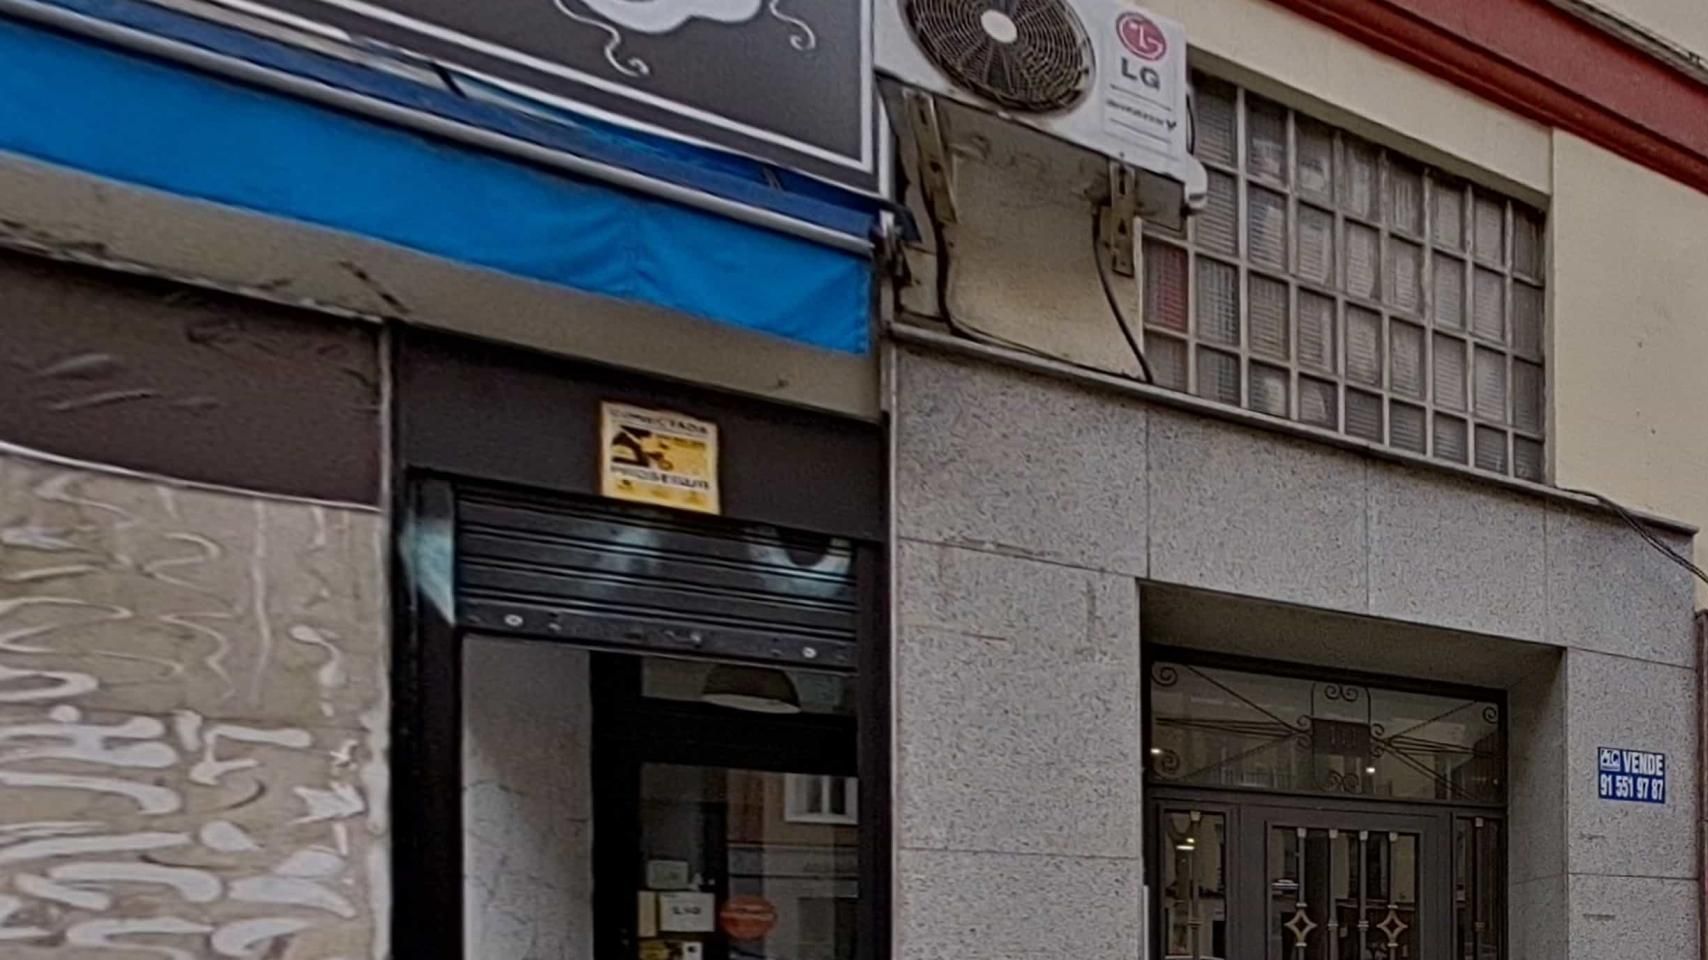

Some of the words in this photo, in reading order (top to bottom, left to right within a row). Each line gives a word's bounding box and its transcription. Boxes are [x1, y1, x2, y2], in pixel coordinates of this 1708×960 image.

[1121, 56, 1160, 91] LG
[1622, 752, 1664, 776] VENDE
[1600, 773, 1613, 797] 91
[1615, 775, 1634, 799] 551
[1636, 777, 1650, 800] 97
[1651, 778, 1664, 801] 87
